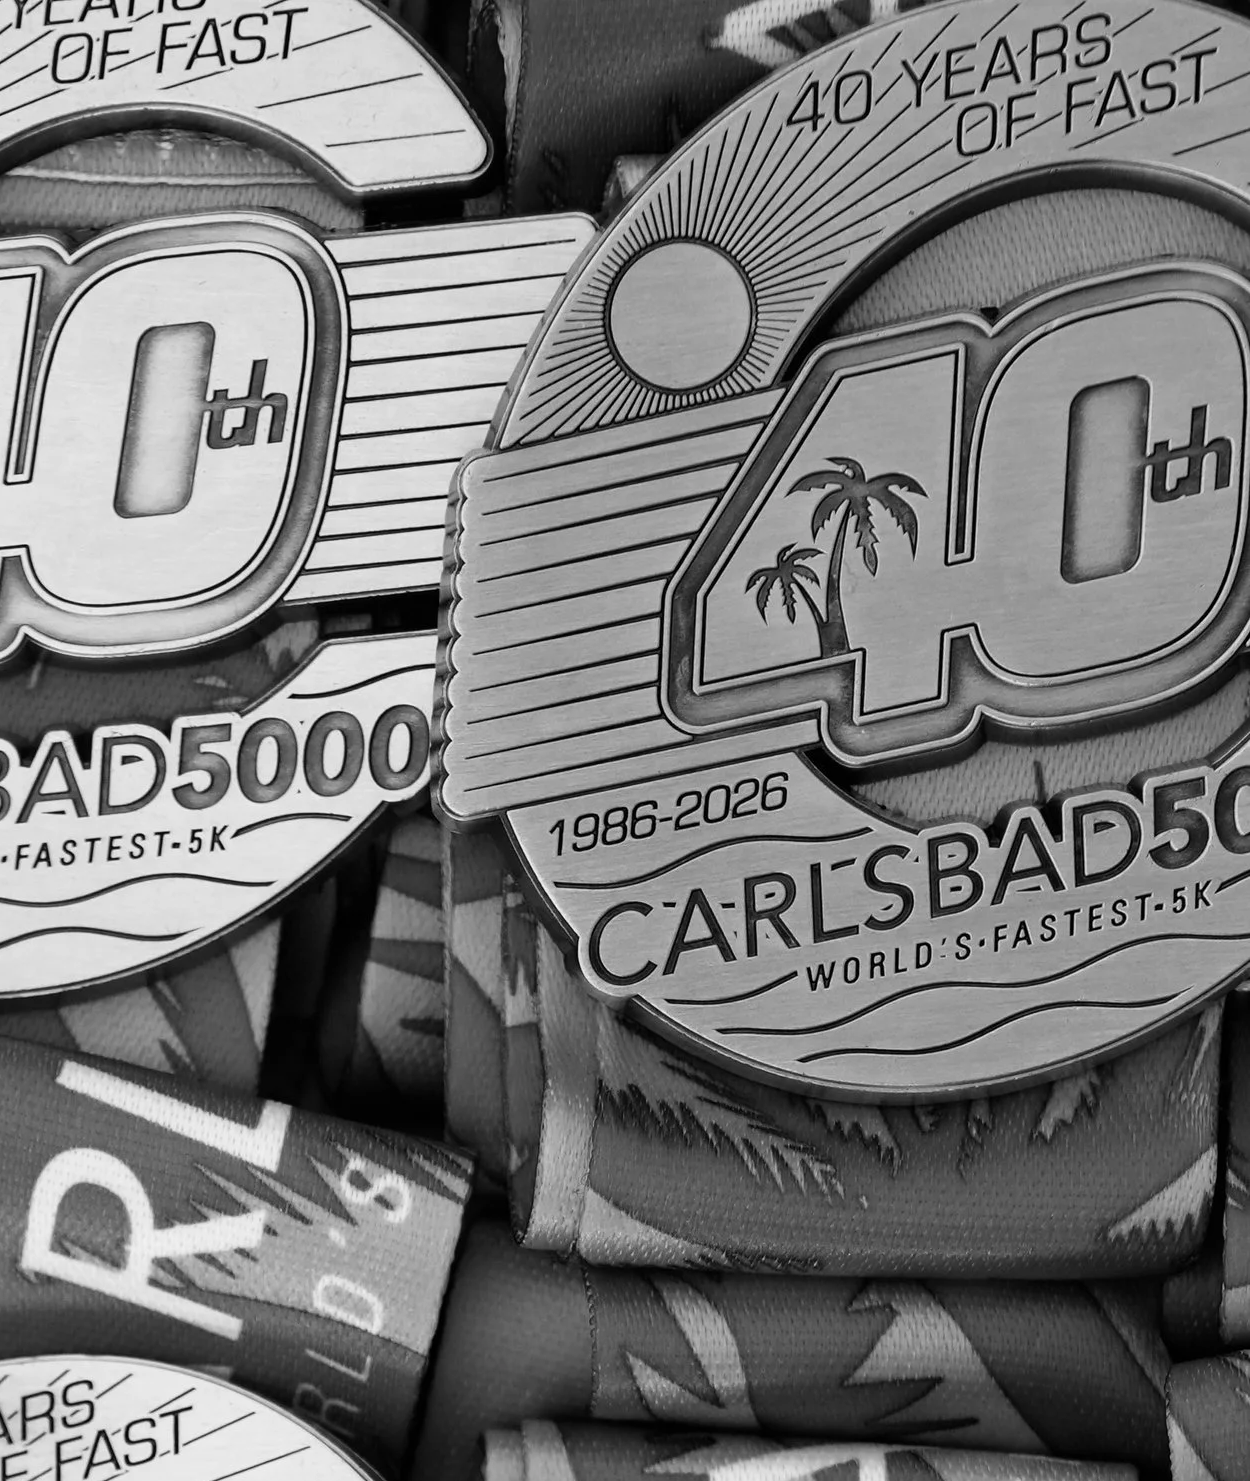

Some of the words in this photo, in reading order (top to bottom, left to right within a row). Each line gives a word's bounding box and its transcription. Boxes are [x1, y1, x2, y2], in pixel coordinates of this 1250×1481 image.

[51, 27, 133, 84] OF
[155, 7, 309, 74] FAST
[786, 70, 873, 132] 40
[901, 13, 1112, 107] YEARS
[955, 93, 1036, 157] OF
[1065, 48, 1219, 134] FAST
[550, 771, 790, 857] 1986-2026
